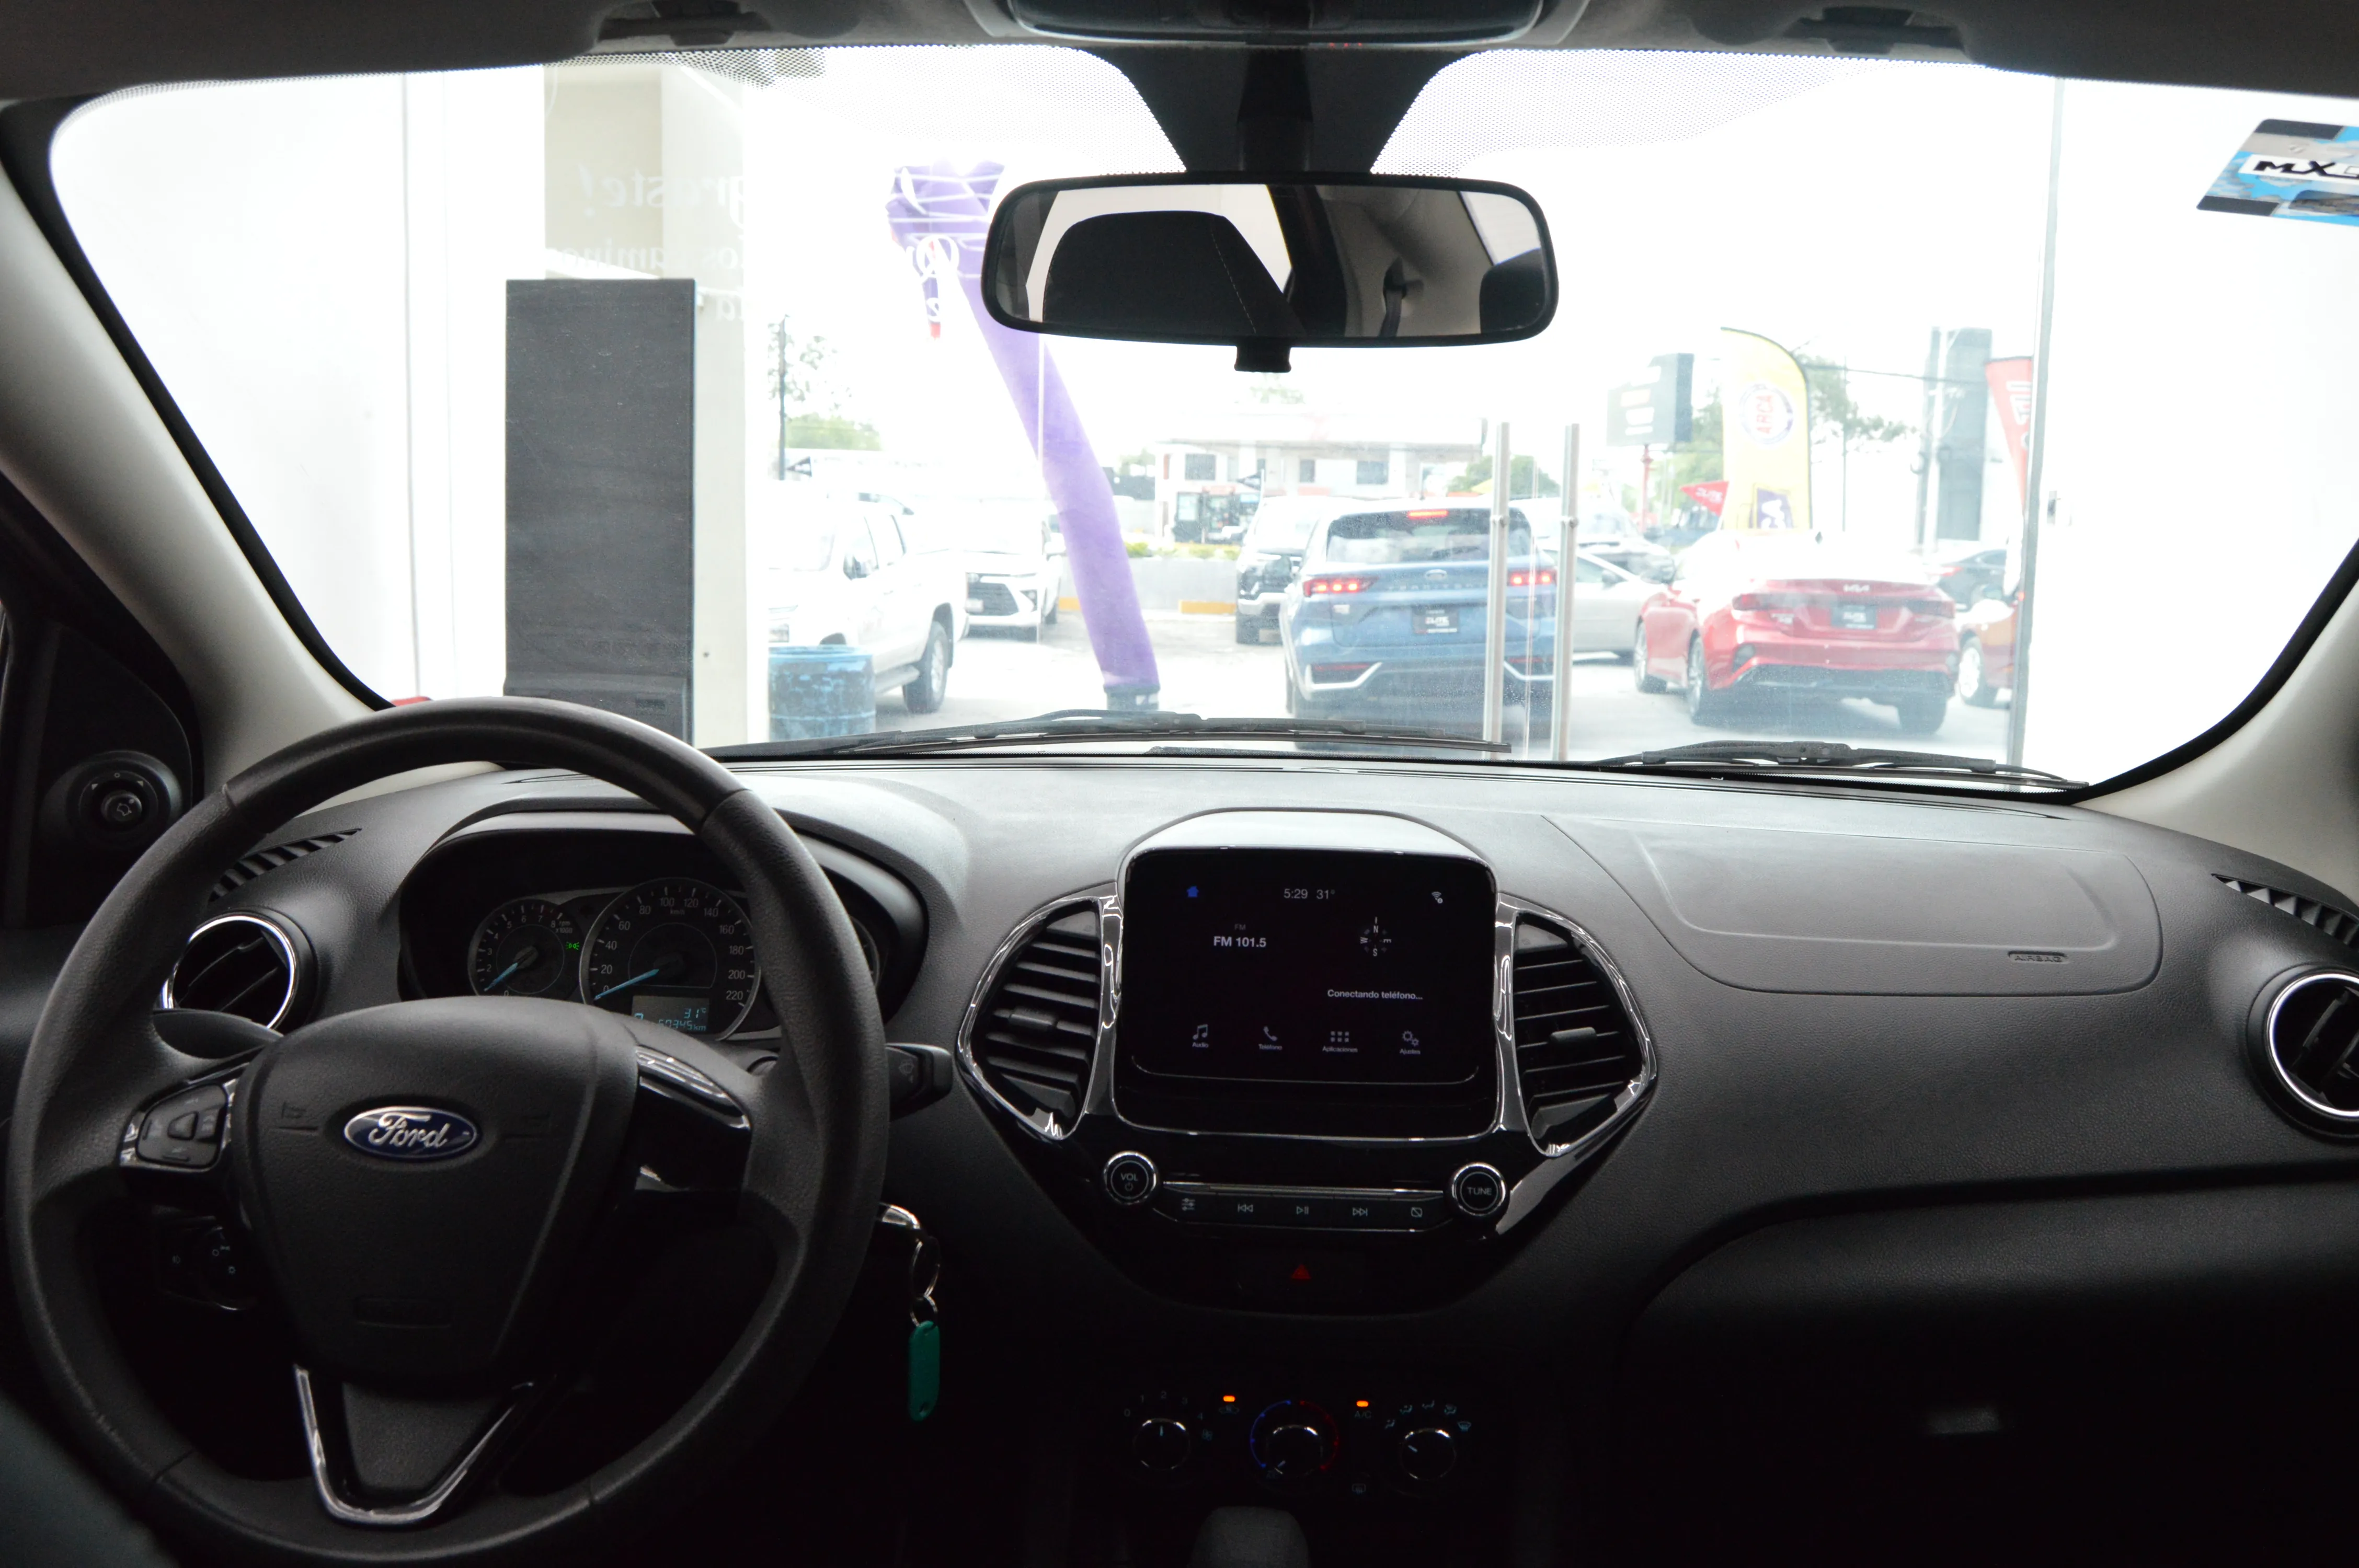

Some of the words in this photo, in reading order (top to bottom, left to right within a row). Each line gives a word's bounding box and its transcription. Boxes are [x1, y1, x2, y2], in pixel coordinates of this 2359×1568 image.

[1284, 889, 1308, 899] 5:29
[660, 897, 675, 907] 100
[683, 898, 698, 908] 120
[639, 905, 651, 915] 80
[703, 908, 719, 917] 140
[619, 921, 631, 930] 60
[719, 925, 735, 935] 160
[1373, 925, 1379, 933] N
[605, 941, 617, 950] 40
[1213, 936, 1232, 947] FM
[1235, 937, 1267, 948] 101.5
[728, 946, 745, 955] 180
[1372, 948, 1378, 956] S
[486, 964, 492, 972] 2
[601, 964, 613, 974] 20
[728, 970, 746, 980] 200
[726, 990, 743, 1000] 220
[1327, 989, 1379, 999] Conectando
[368, 1112, 450, 1148] Ford
[1467, 1186, 1492, 1196] TUNE
[1160, 1390, 1167, 1399] 2
[1354, 1410, 1372, 1419] A/C
